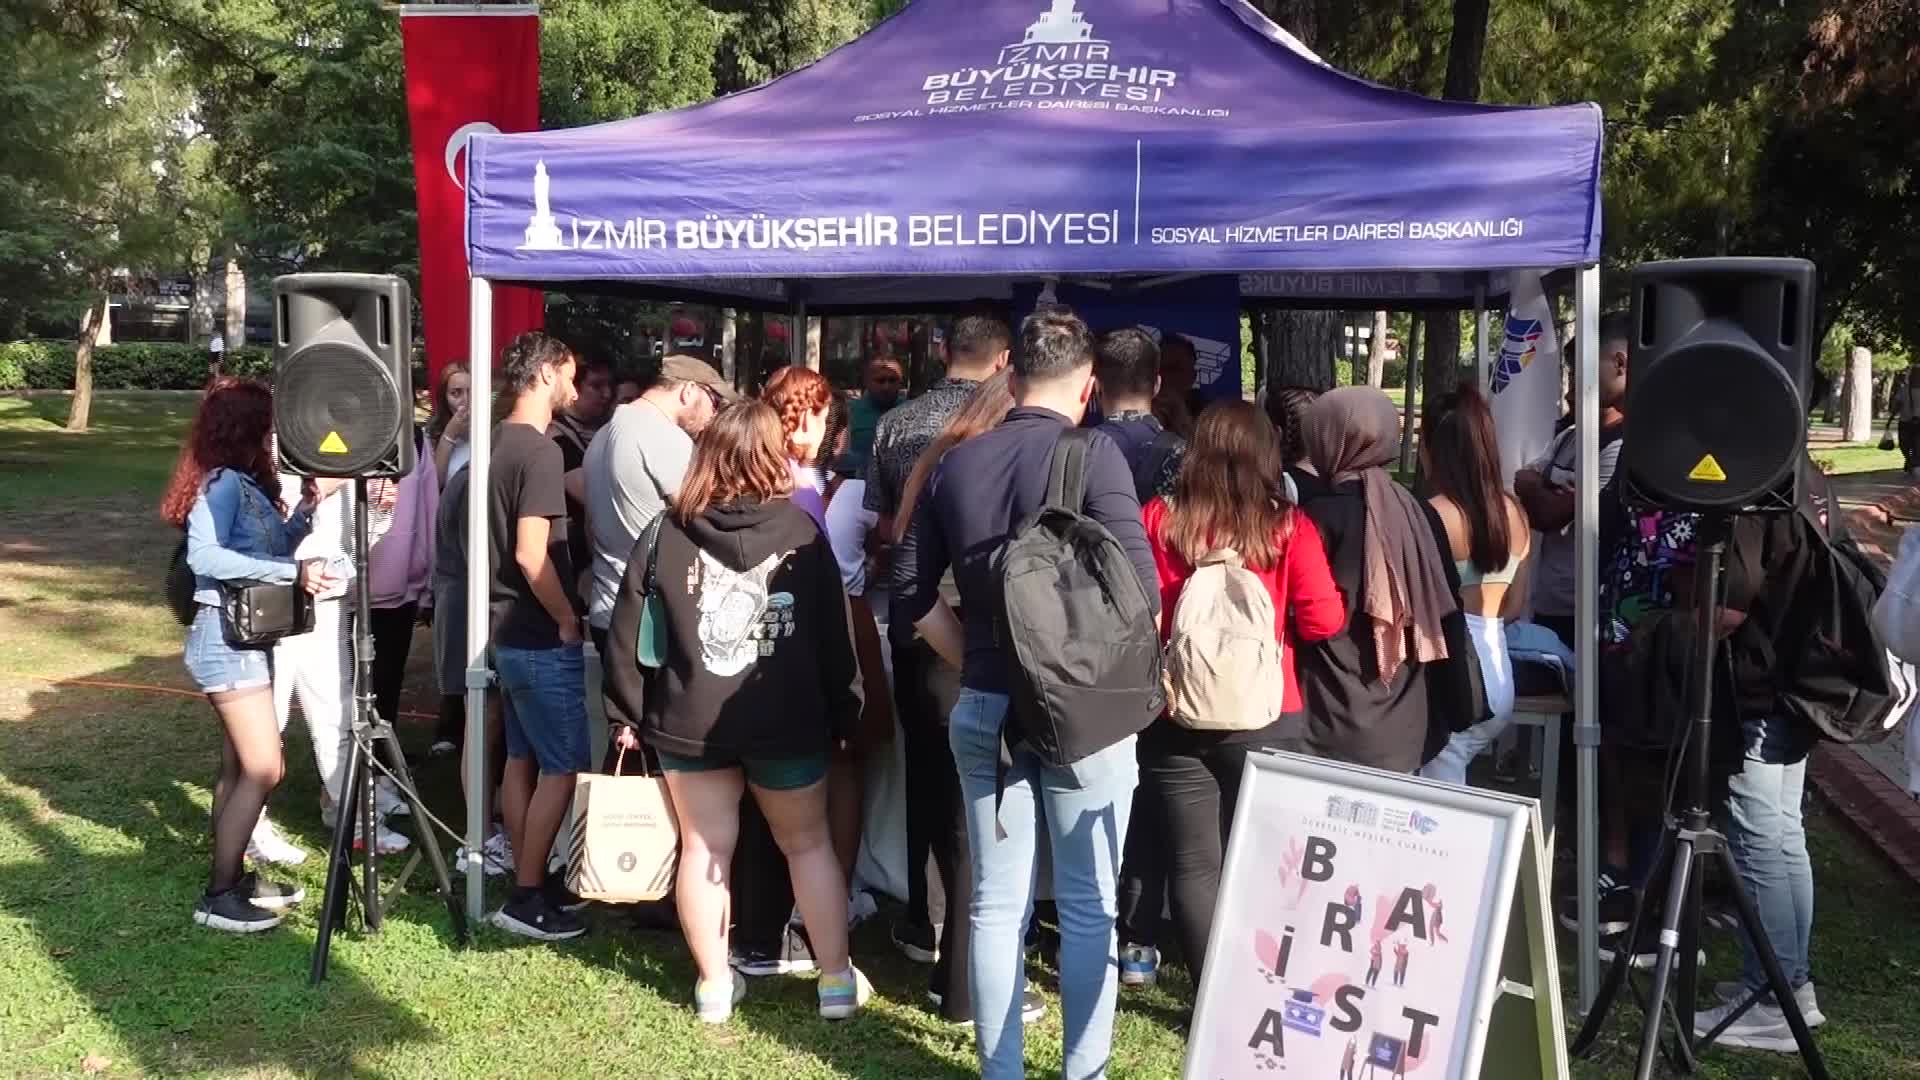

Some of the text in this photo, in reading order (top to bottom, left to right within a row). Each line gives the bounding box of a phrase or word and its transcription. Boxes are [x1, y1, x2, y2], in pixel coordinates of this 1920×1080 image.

[571, 209, 1119, 252] İZMİR BÜYÜKŞEHİR BELEDİYESİ
[1151, 218, 1524, 244] SOSYAL HİZMETLER DAİRESİ BAŞKANLIĞI
[1301, 836, 1337, 882] B
[1320, 902, 1356, 953] R
[1384, 887, 1427, 940] A
[1329, 984, 1365, 1032] S
[1402, 1006, 1439, 1058] T
[1248, 1008, 1285, 1057] A
